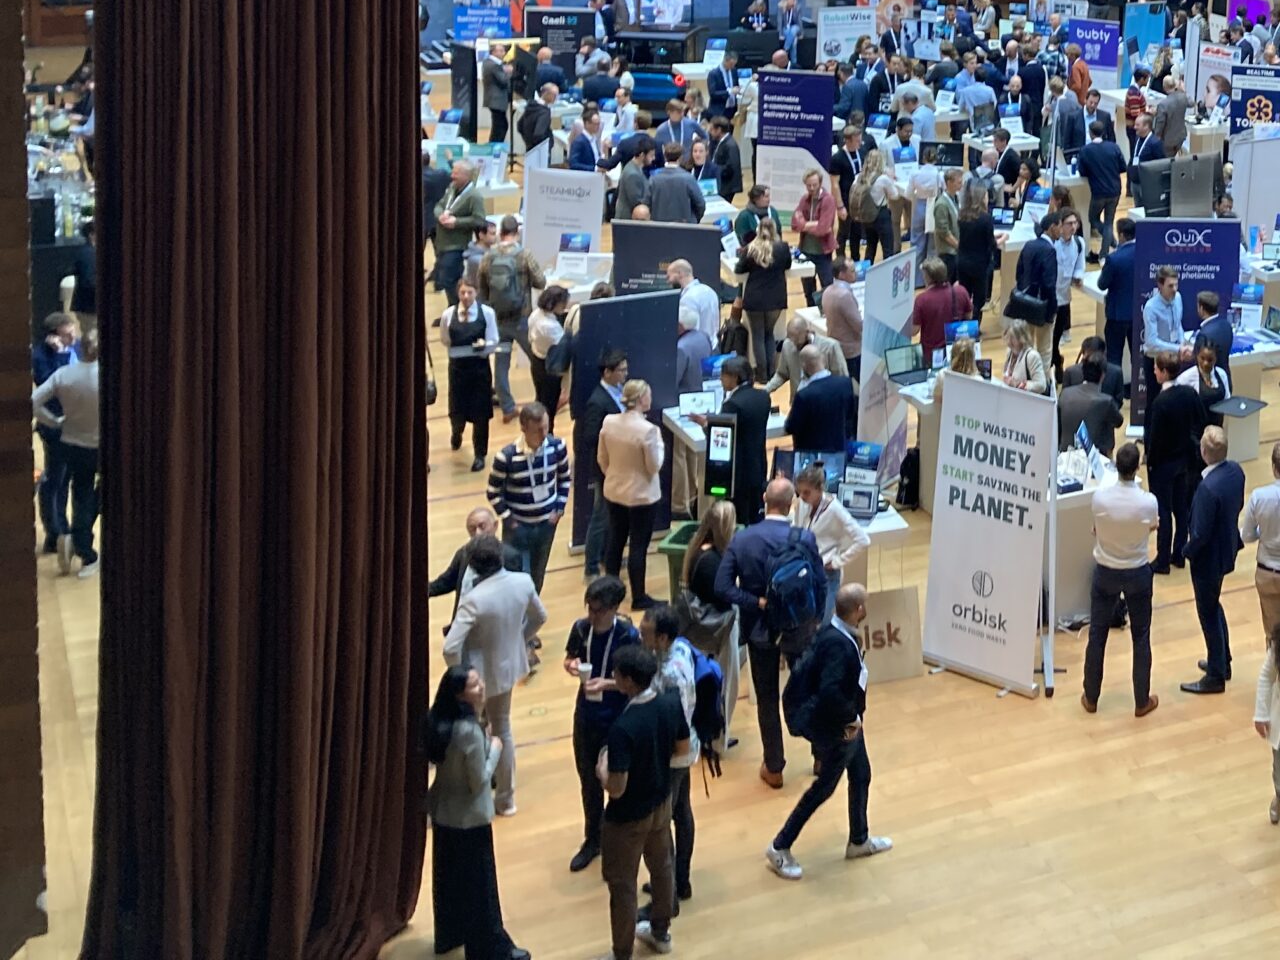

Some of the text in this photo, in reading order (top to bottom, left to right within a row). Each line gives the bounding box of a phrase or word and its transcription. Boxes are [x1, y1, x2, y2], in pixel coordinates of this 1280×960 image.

[1076, 26, 1111, 45] bubty
[1181, 271, 1216, 281] photonics
[1183, 263, 1221, 274] Computers
[953, 414, 1036, 447] STOP WASTING
[952, 433, 1036, 478] MONEY.
[942, 463, 1042, 503] START SAVING THE
[948, 484, 1033, 530] PLANET.
[951, 602, 1008, 634] orbisk
